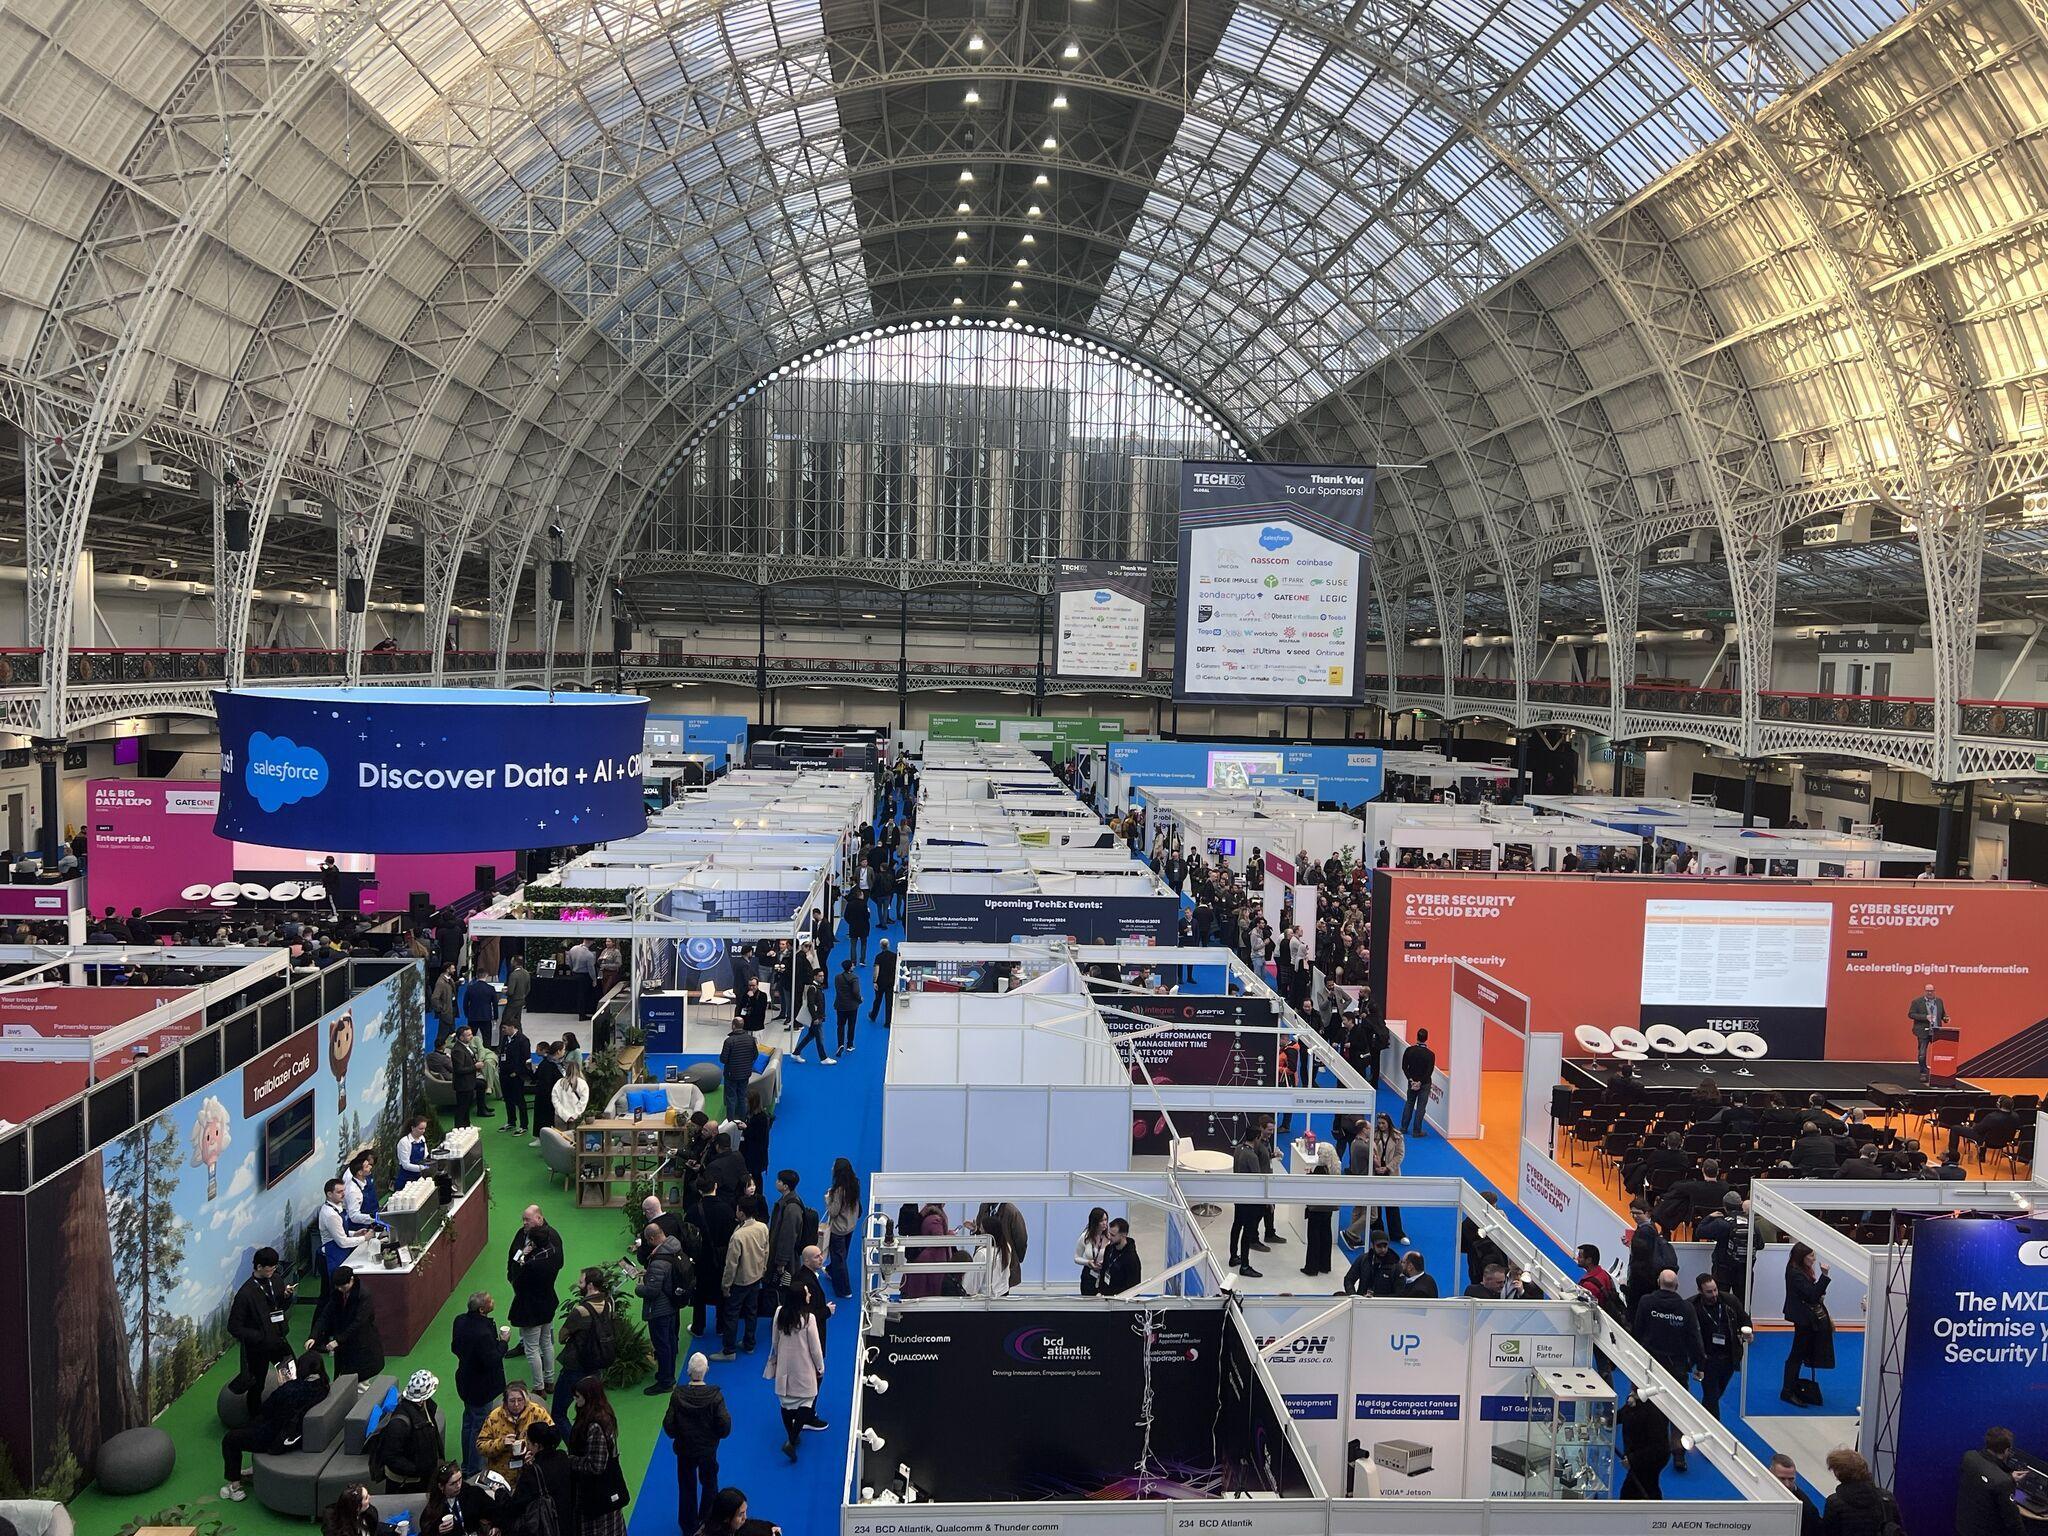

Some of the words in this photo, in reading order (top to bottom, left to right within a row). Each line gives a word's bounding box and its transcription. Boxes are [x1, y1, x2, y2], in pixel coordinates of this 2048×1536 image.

[1311, 475, 1342, 484] Thank
[1344, 476, 1364, 484] You
[1298, 486, 1315, 494] Our
[1318, 486, 1364, 497] Sponsors!
[1251, 557, 1290, 565] nasscom
[1200, 592, 1256, 600] zondacrypto
[253, 761, 319, 782] salesforce
[358, 761, 496, 790] Discover
[504, 762, 568, 788] Data
[574, 768, 588, 786] +
[593, 758, 612, 784] AI
[96, 835, 140, 843] Enterprise
[985, 900, 1032, 910] Upcoming
[1406, 894, 1449, 904] CYBER
[1452, 895, 1515, 906] SECURITY
[1405, 906, 1416, 916] &
[1418, 906, 1463, 916] CLOUD
[1465, 907, 1500, 918] EXPO
[1850, 904, 1892, 914] CYBER
[1893, 905, 1954, 915] SECURITY
[1849, 916, 1858, 925] &
[1861, 916, 1904, 926] CLOUD
[1906, 917, 1940, 926] EXPO
[1461, 956, 1506, 967] Security
[1846, 964, 1912, 975] Accelerating
[1914, 964, 1948, 975] Digital
[1950, 964, 2029, 974] Transformation
[1707, 1020, 1759, 1031] TECHEX
[254, 1068, 291, 1102] Trailblazer
[292, 1053, 310, 1076] Café
[1526, 1163, 1544, 1184] CYBER
[1544, 1176, 1571, 1207] SECURITY
[1531, 1178, 1548, 1198] CLOUD
[1549, 1193, 1564, 1212] EXPO
[1955, 1292, 1996, 1312] The
[1651, 1311, 1683, 1321] Creative
[1934, 1317, 2035, 1342] Optimise
[890, 1334, 951, 1343] Thundercomm
[1043, 1337, 1063, 1346] bcd
[1391, 1334, 1420, 1355] UP
[1047, 1346, 1090, 1355] atlantik
[1945, 1343, 2038, 1368] Security
[875, 1525, 896, 1533] BCD
[898, 1524, 934, 1534] Atlantik,
[936, 1523, 982, 1533] Qualcomm
[985, 1524, 991, 1532] &
[994, 1523, 1029, 1532] Thunder
[1220, 1519, 1252, 1527] Atlantik
[1705, 1522, 1752, 1531] Technology
